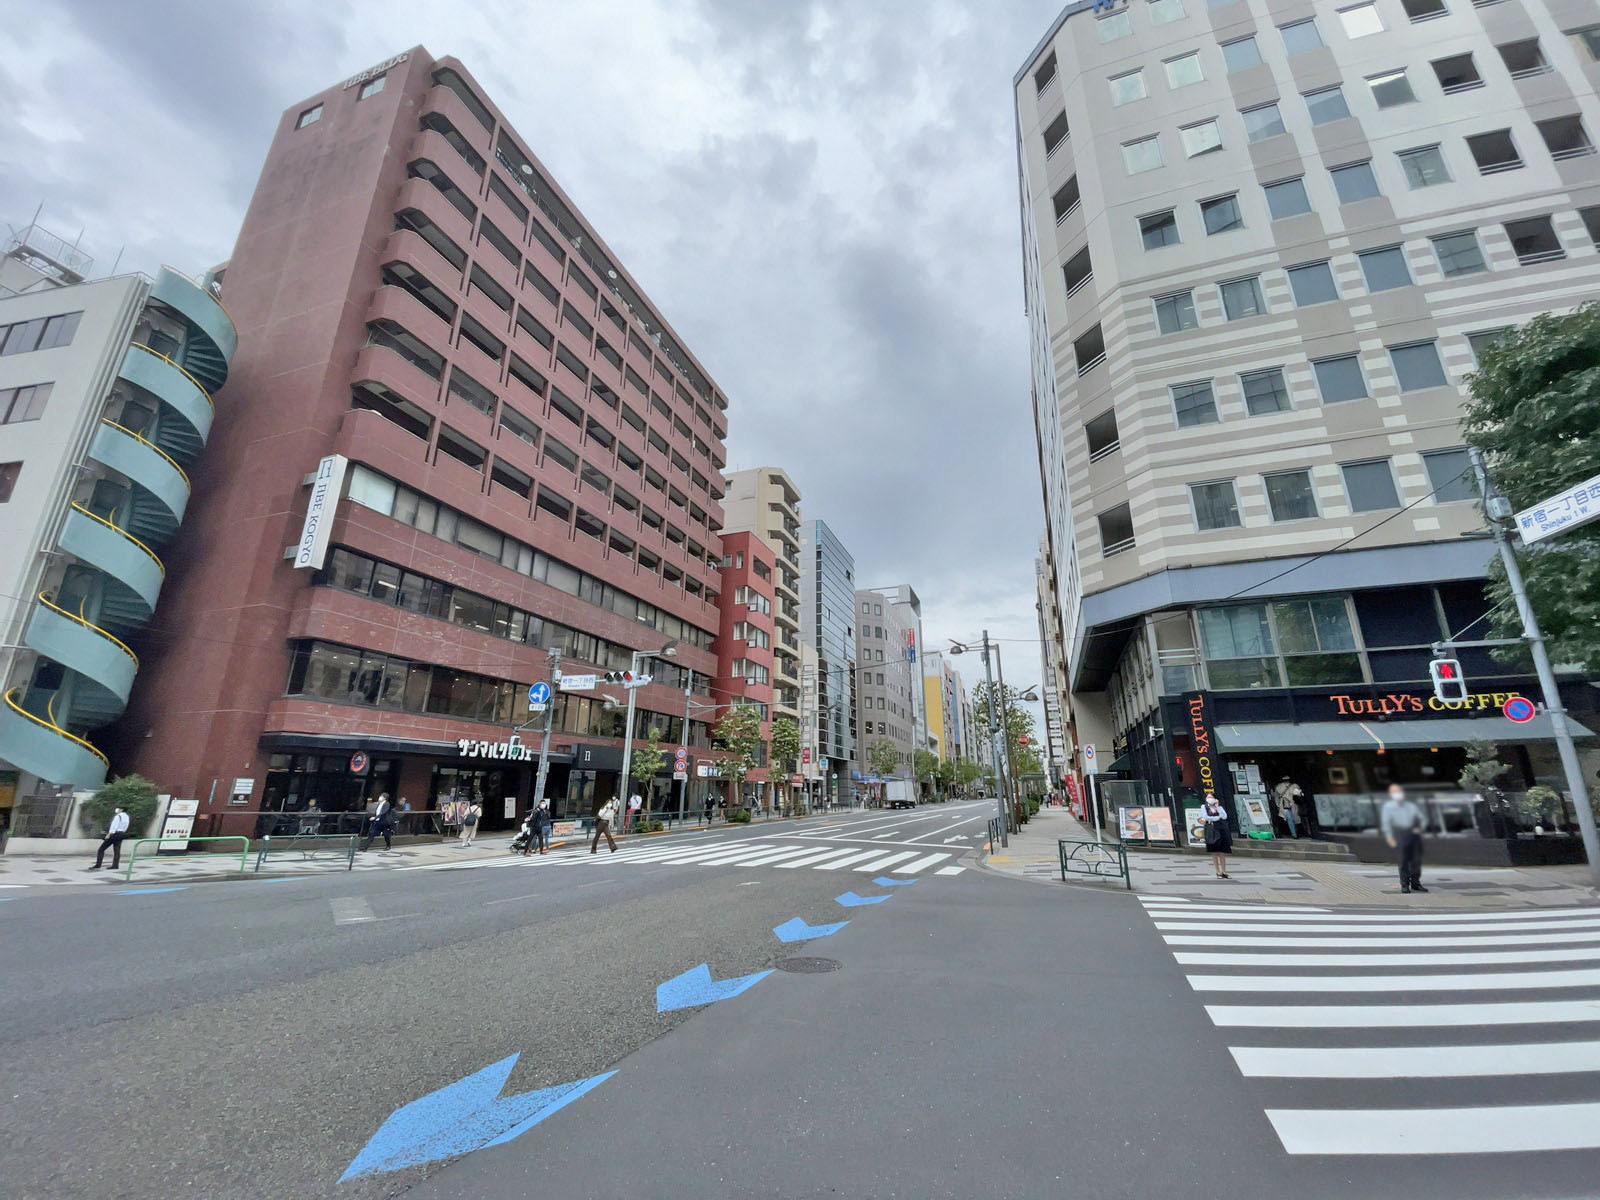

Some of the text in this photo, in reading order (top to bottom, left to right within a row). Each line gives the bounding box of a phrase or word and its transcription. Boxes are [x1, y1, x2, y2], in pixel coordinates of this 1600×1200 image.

[1520, 483, 1600, 529] 新宿一丁目西
[1540, 514, 1572, 532] Shinjuku
[300, 514, 319, 564] KOGYO
[458, 738, 532, 761] サンマルクフェ
